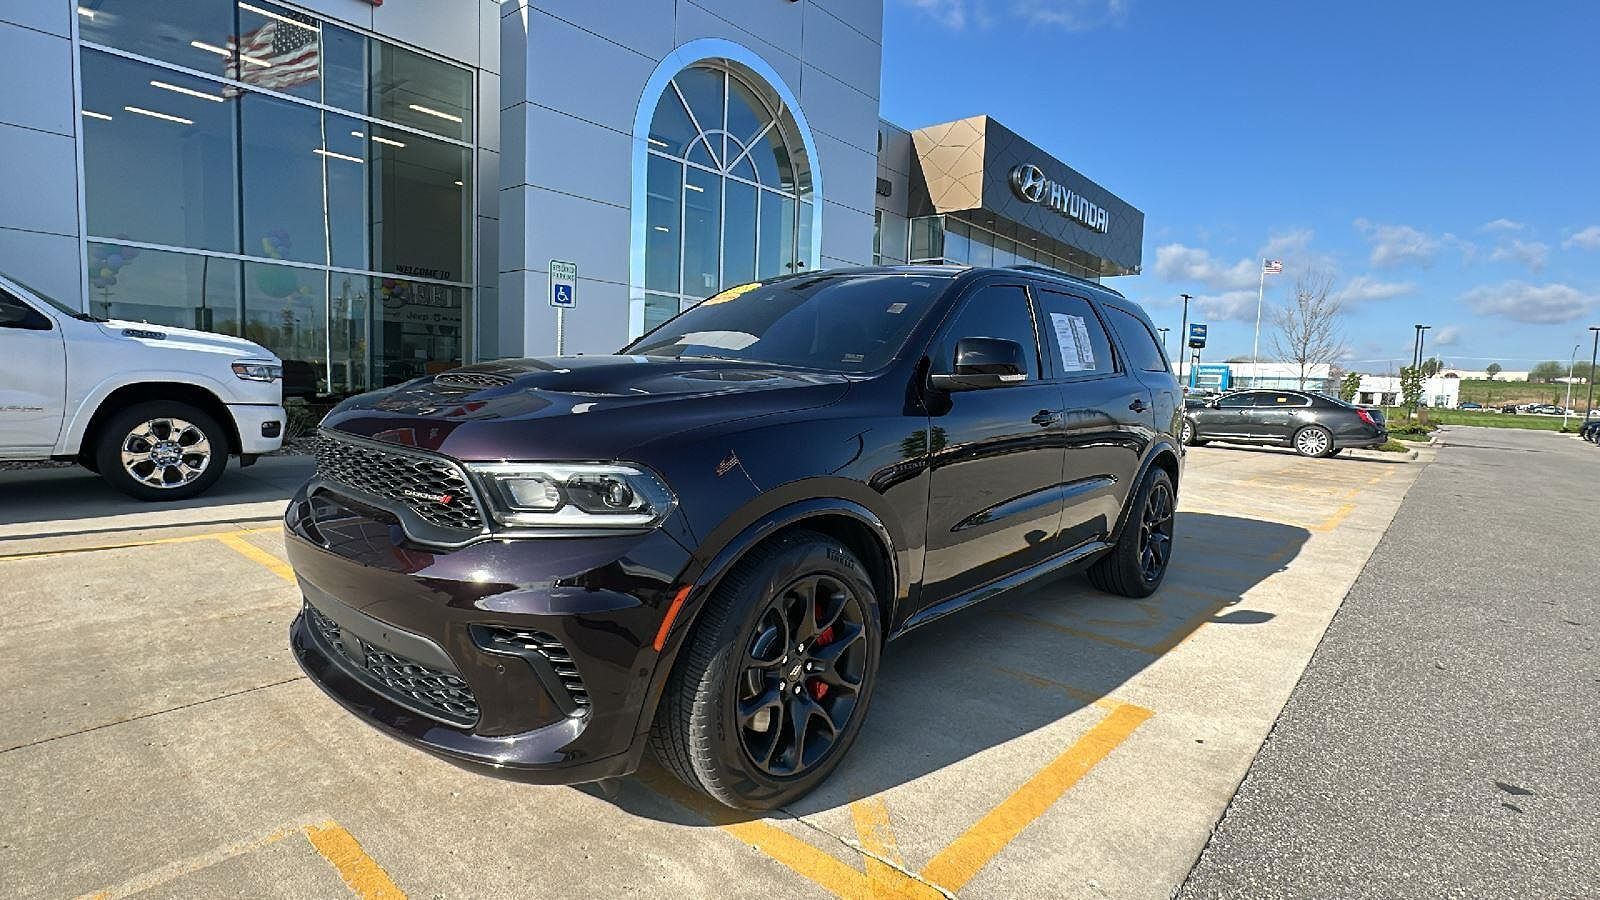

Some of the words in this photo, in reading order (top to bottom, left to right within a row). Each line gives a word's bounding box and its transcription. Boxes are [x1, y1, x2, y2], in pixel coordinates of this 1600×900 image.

[1050, 181, 1109, 234] HYUNDAI
[396, 264, 438, 278] WELCOME
[439, 270, 450, 279] TO
